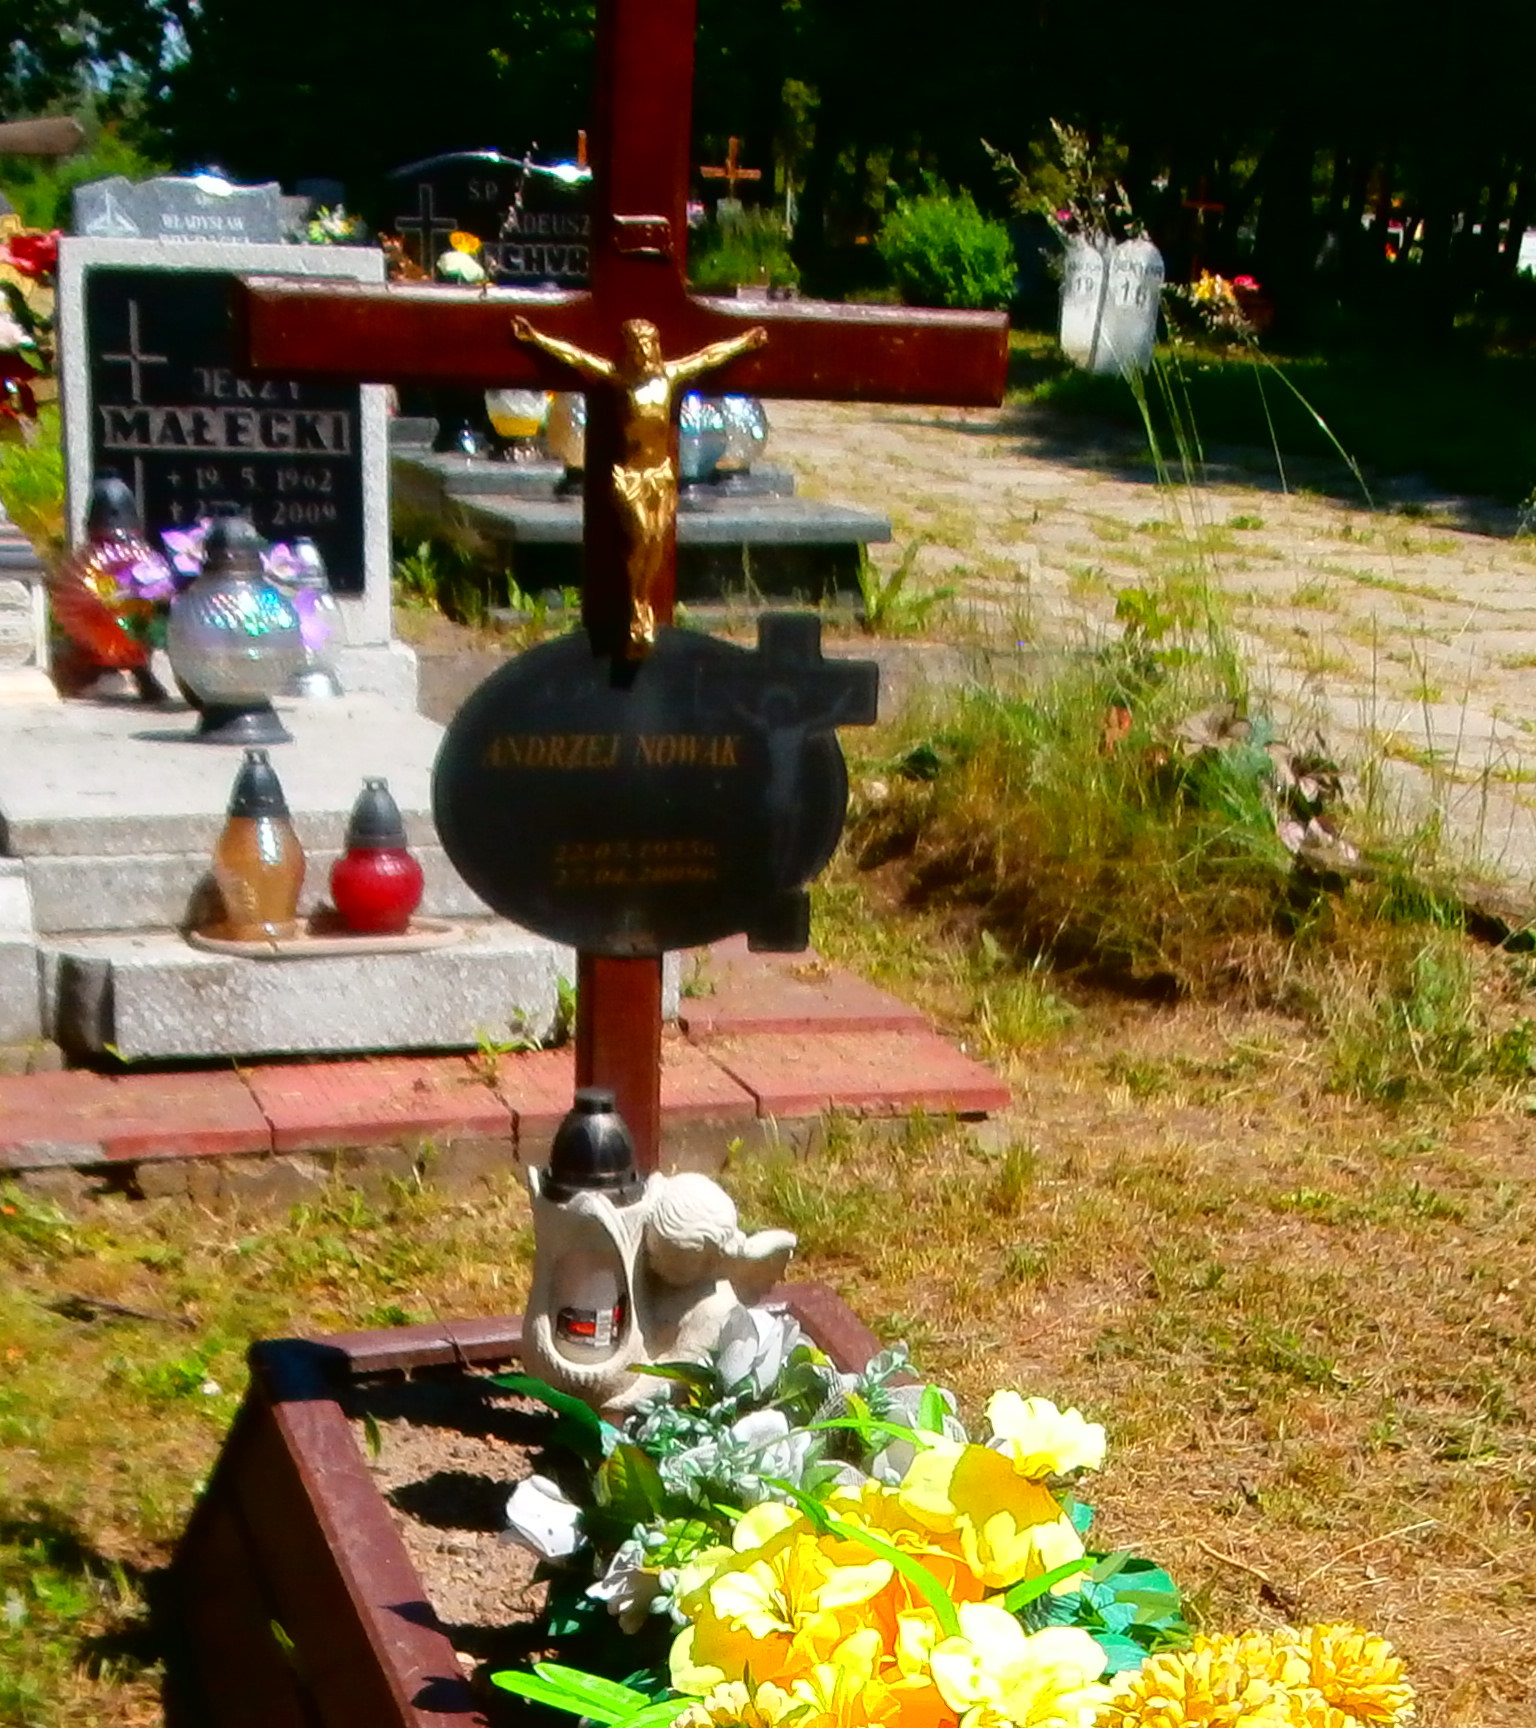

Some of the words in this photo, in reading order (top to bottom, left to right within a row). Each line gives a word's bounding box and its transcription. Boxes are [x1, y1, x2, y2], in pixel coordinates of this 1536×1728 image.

[99, 405, 350, 453] MAŁECKI
[482, 733, 622, 769] ANDRZEJ
[635, 733, 741, 768] NOWAK
